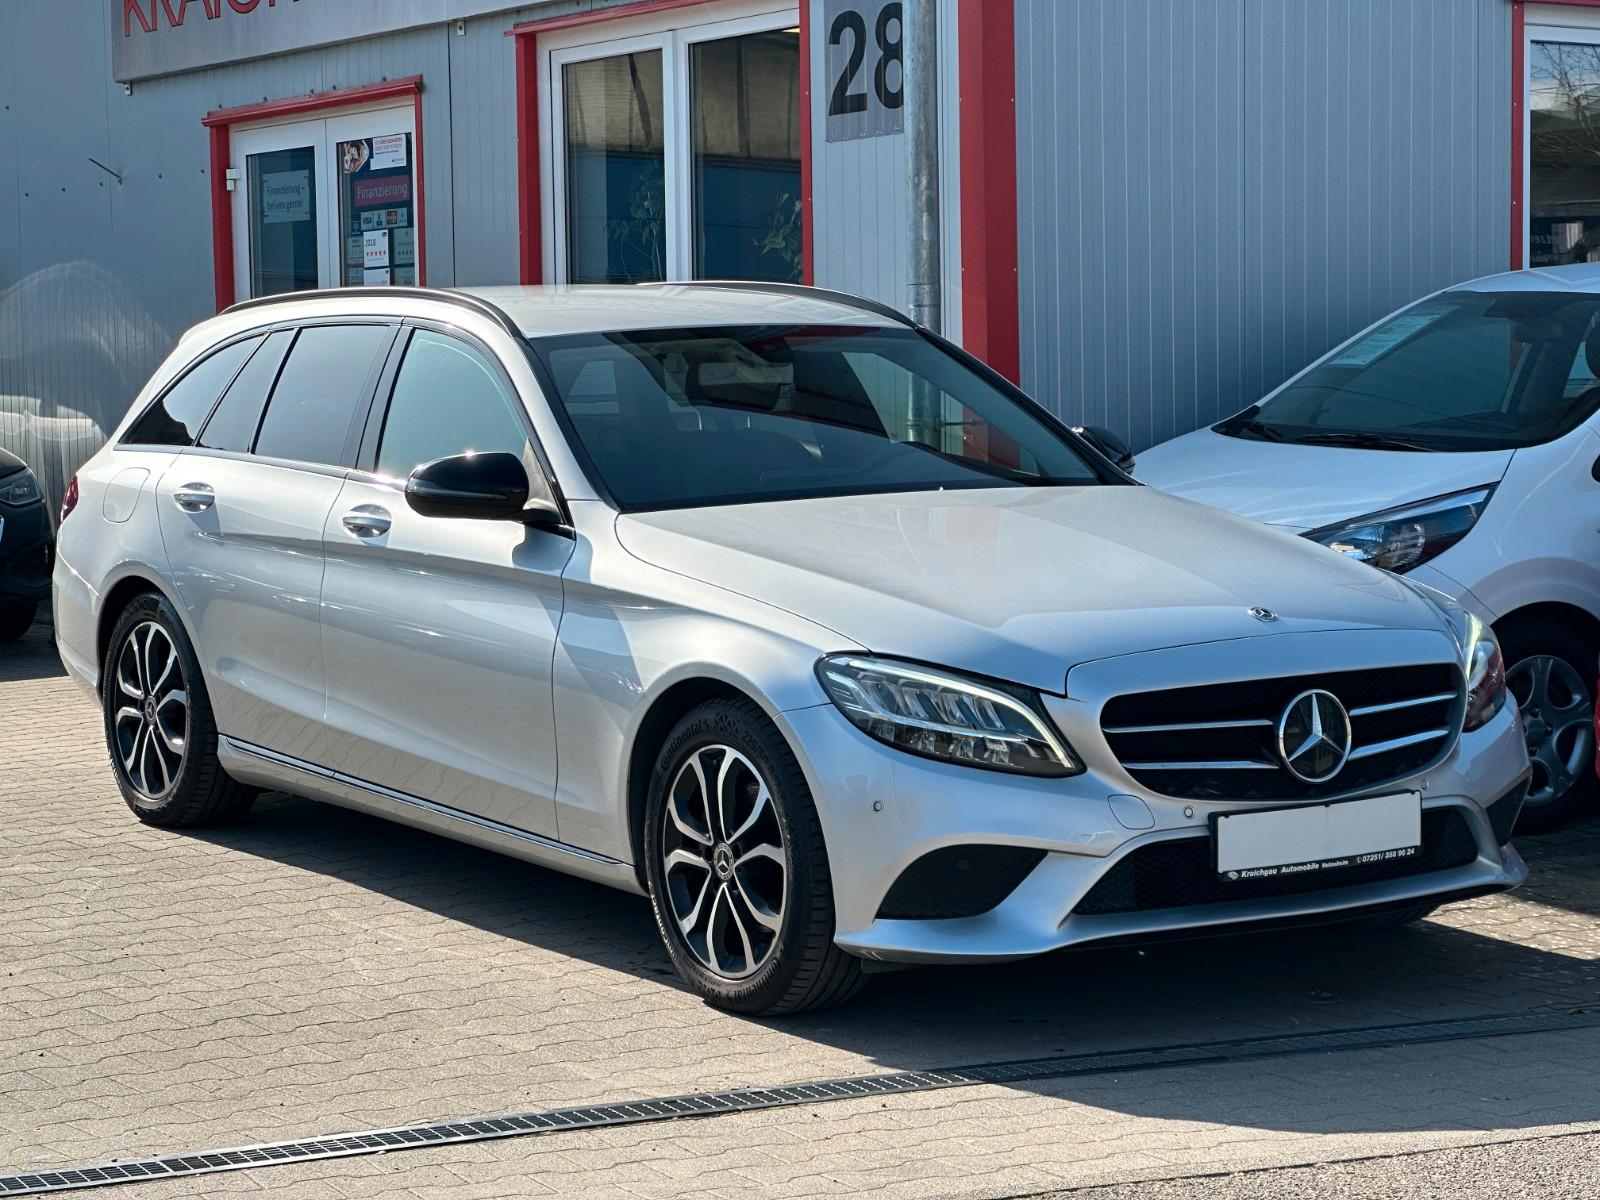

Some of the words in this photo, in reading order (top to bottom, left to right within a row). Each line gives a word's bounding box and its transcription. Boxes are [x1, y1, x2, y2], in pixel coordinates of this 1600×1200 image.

[828, 2, 904, 116] 28
[357, 183, 408, 200] Finanzierung
[1241, 868, 1278, 878] Kraichgau
[1281, 862, 1320, 874] Automobile
[1406, 848, 1415, 856] 24
